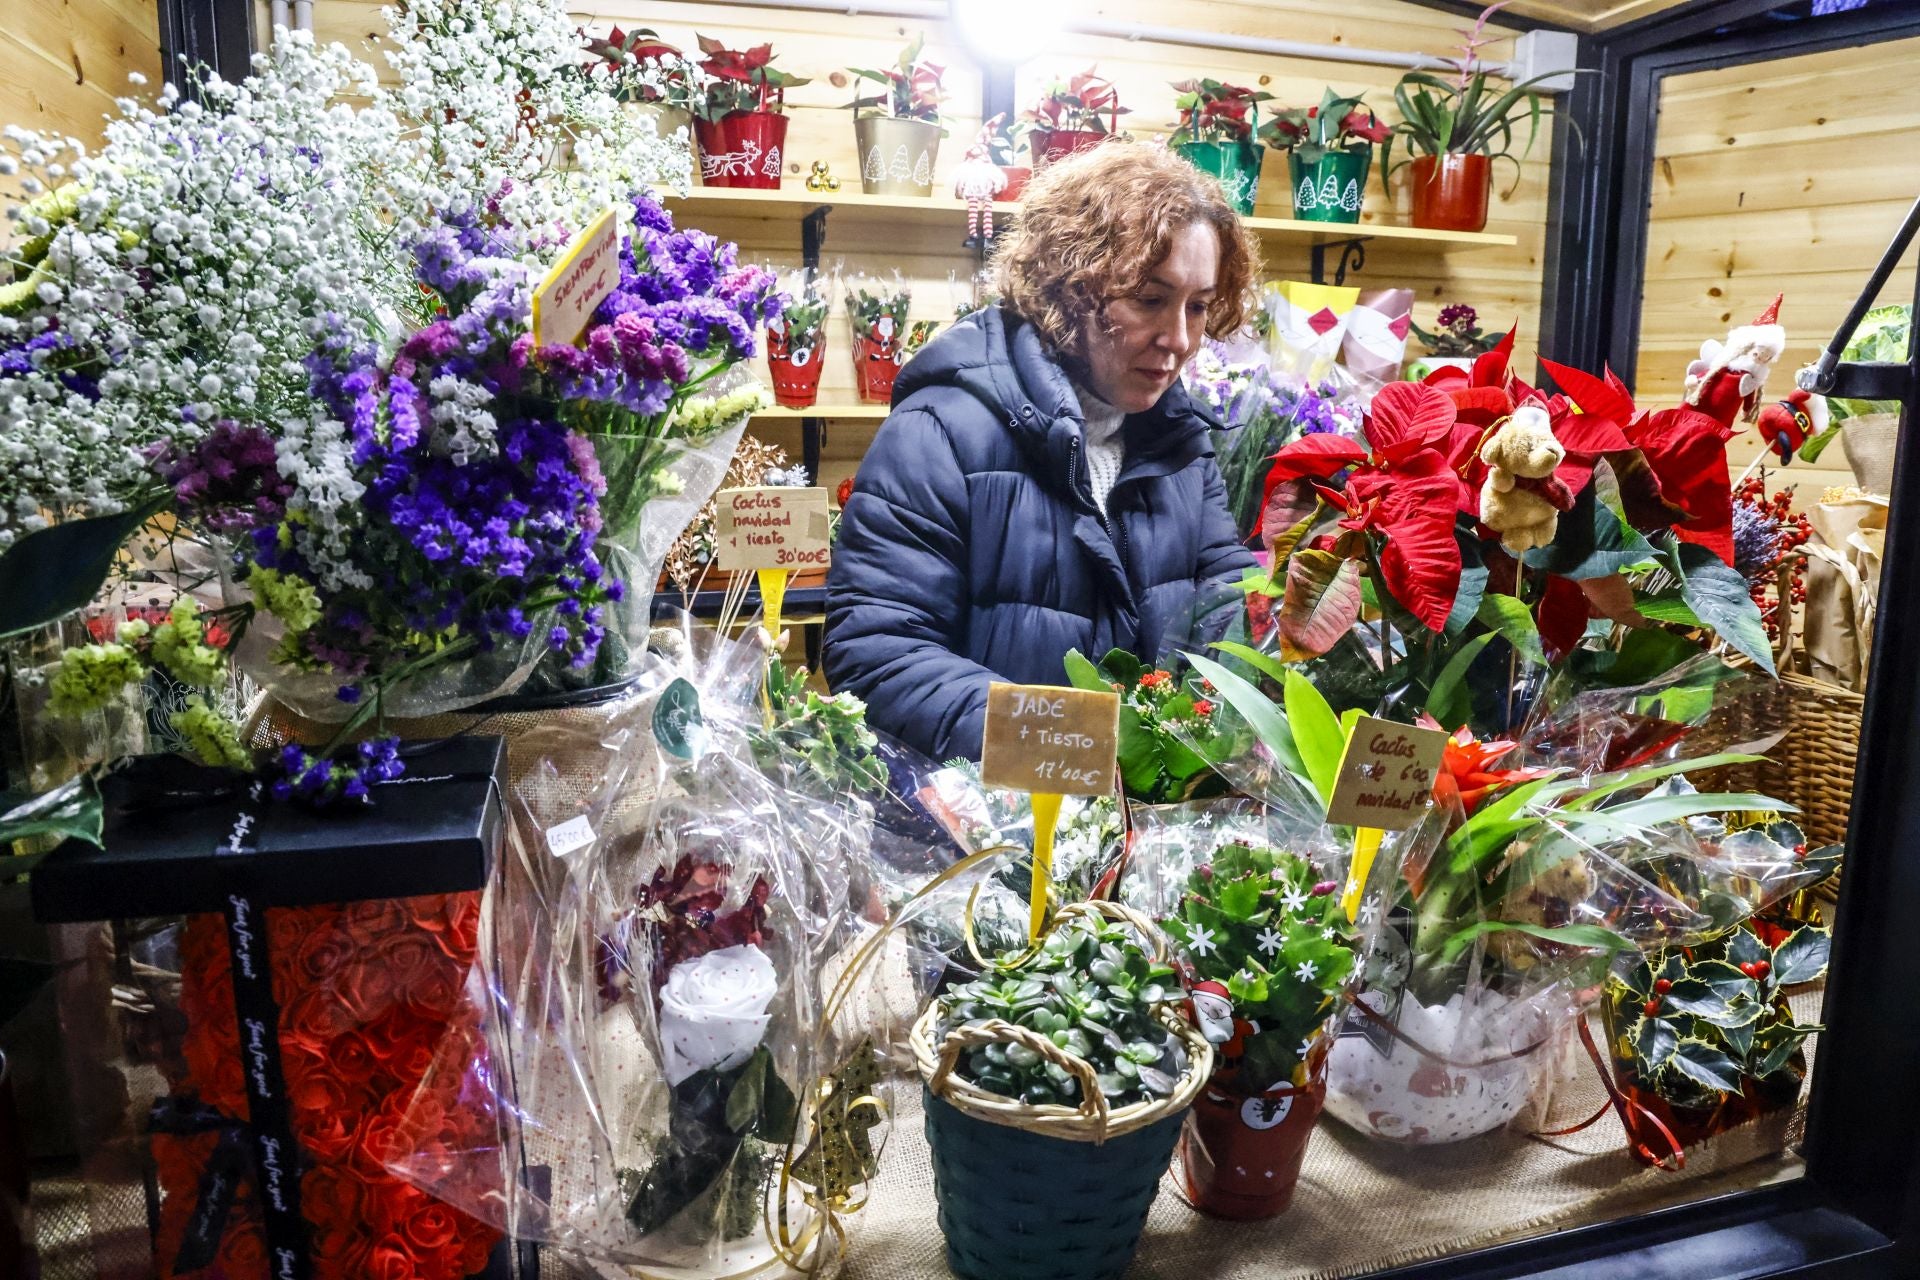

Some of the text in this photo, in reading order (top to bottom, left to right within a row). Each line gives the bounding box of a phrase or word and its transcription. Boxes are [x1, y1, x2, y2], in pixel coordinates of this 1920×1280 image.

[733, 511, 791, 528] navidad
[746, 529, 785, 545] tiesto
[1010, 692, 1066, 718] JADE
[1369, 733, 1416, 759] Cactus
[1356, 789, 1415, 811] navidad
